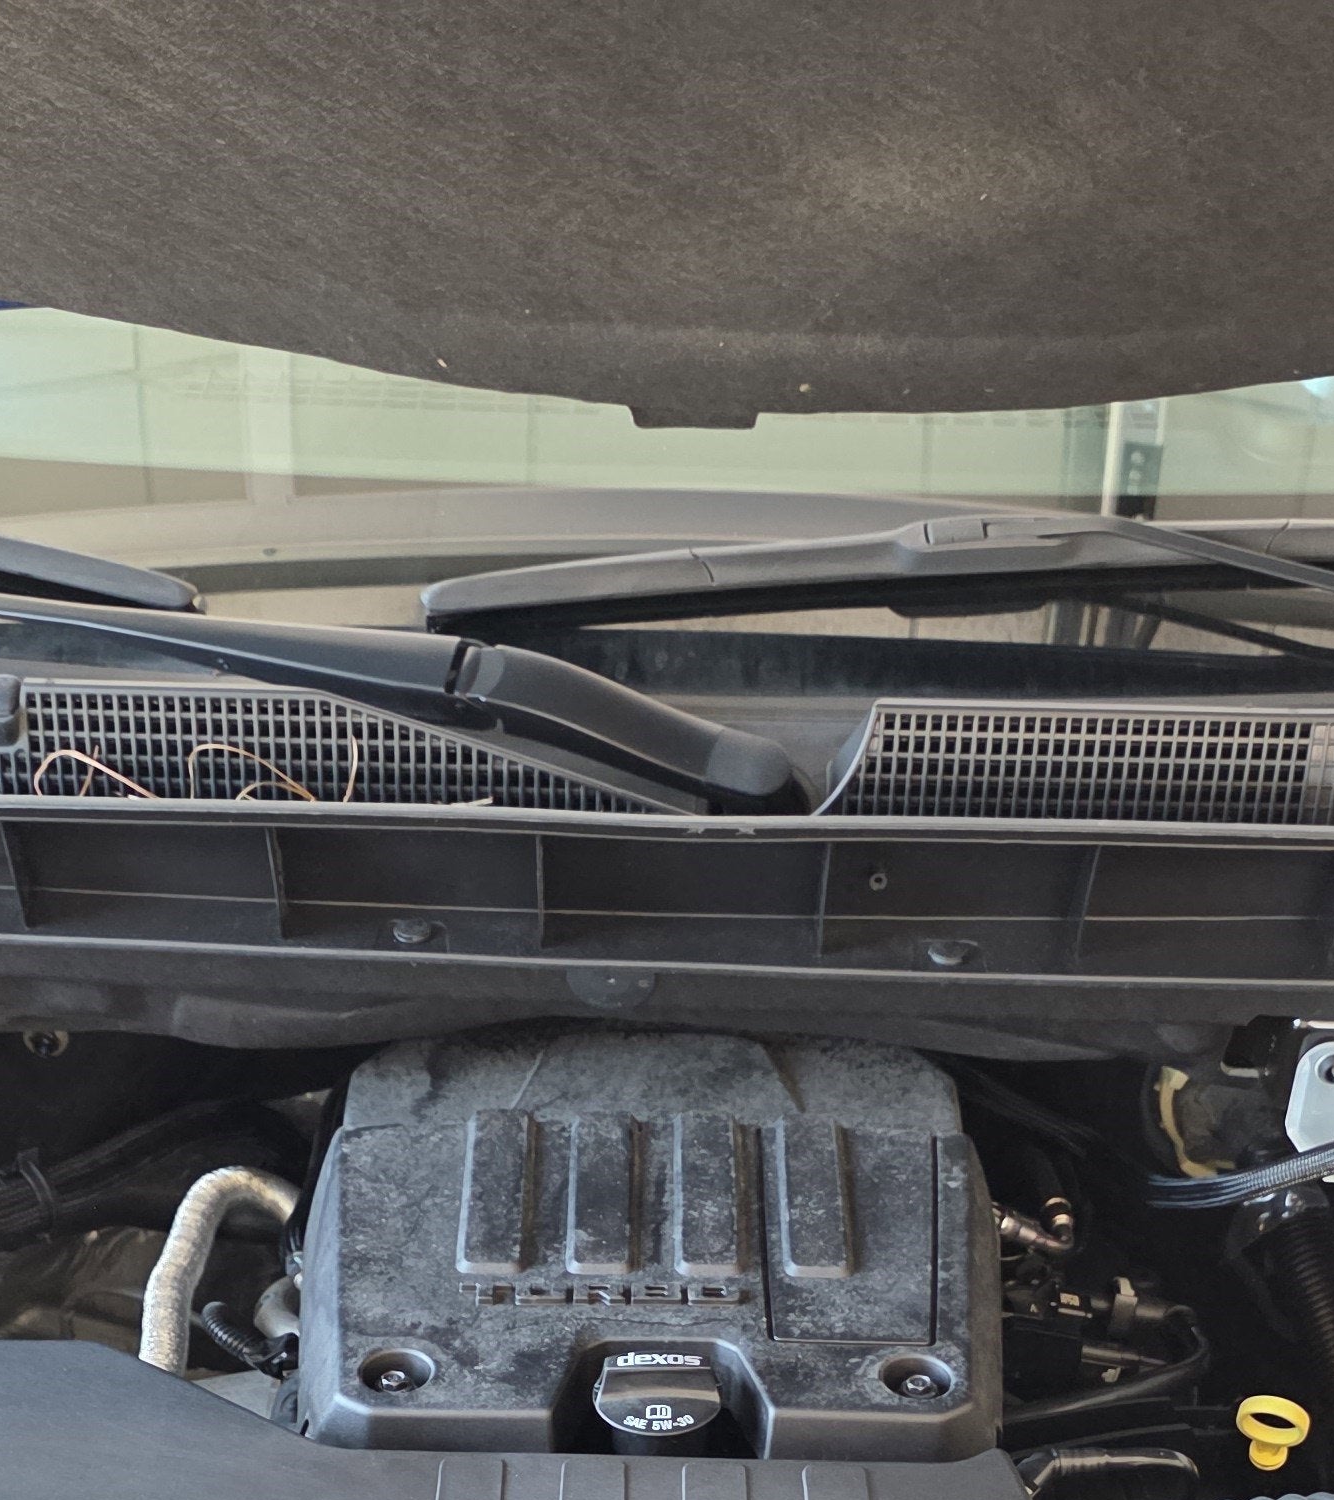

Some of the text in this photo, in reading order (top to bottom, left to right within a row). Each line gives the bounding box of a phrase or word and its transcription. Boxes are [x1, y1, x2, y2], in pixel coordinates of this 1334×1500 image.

[617, 1352, 703, 1367] dexos
[623, 1415, 695, 1431] SAE 5W-30
